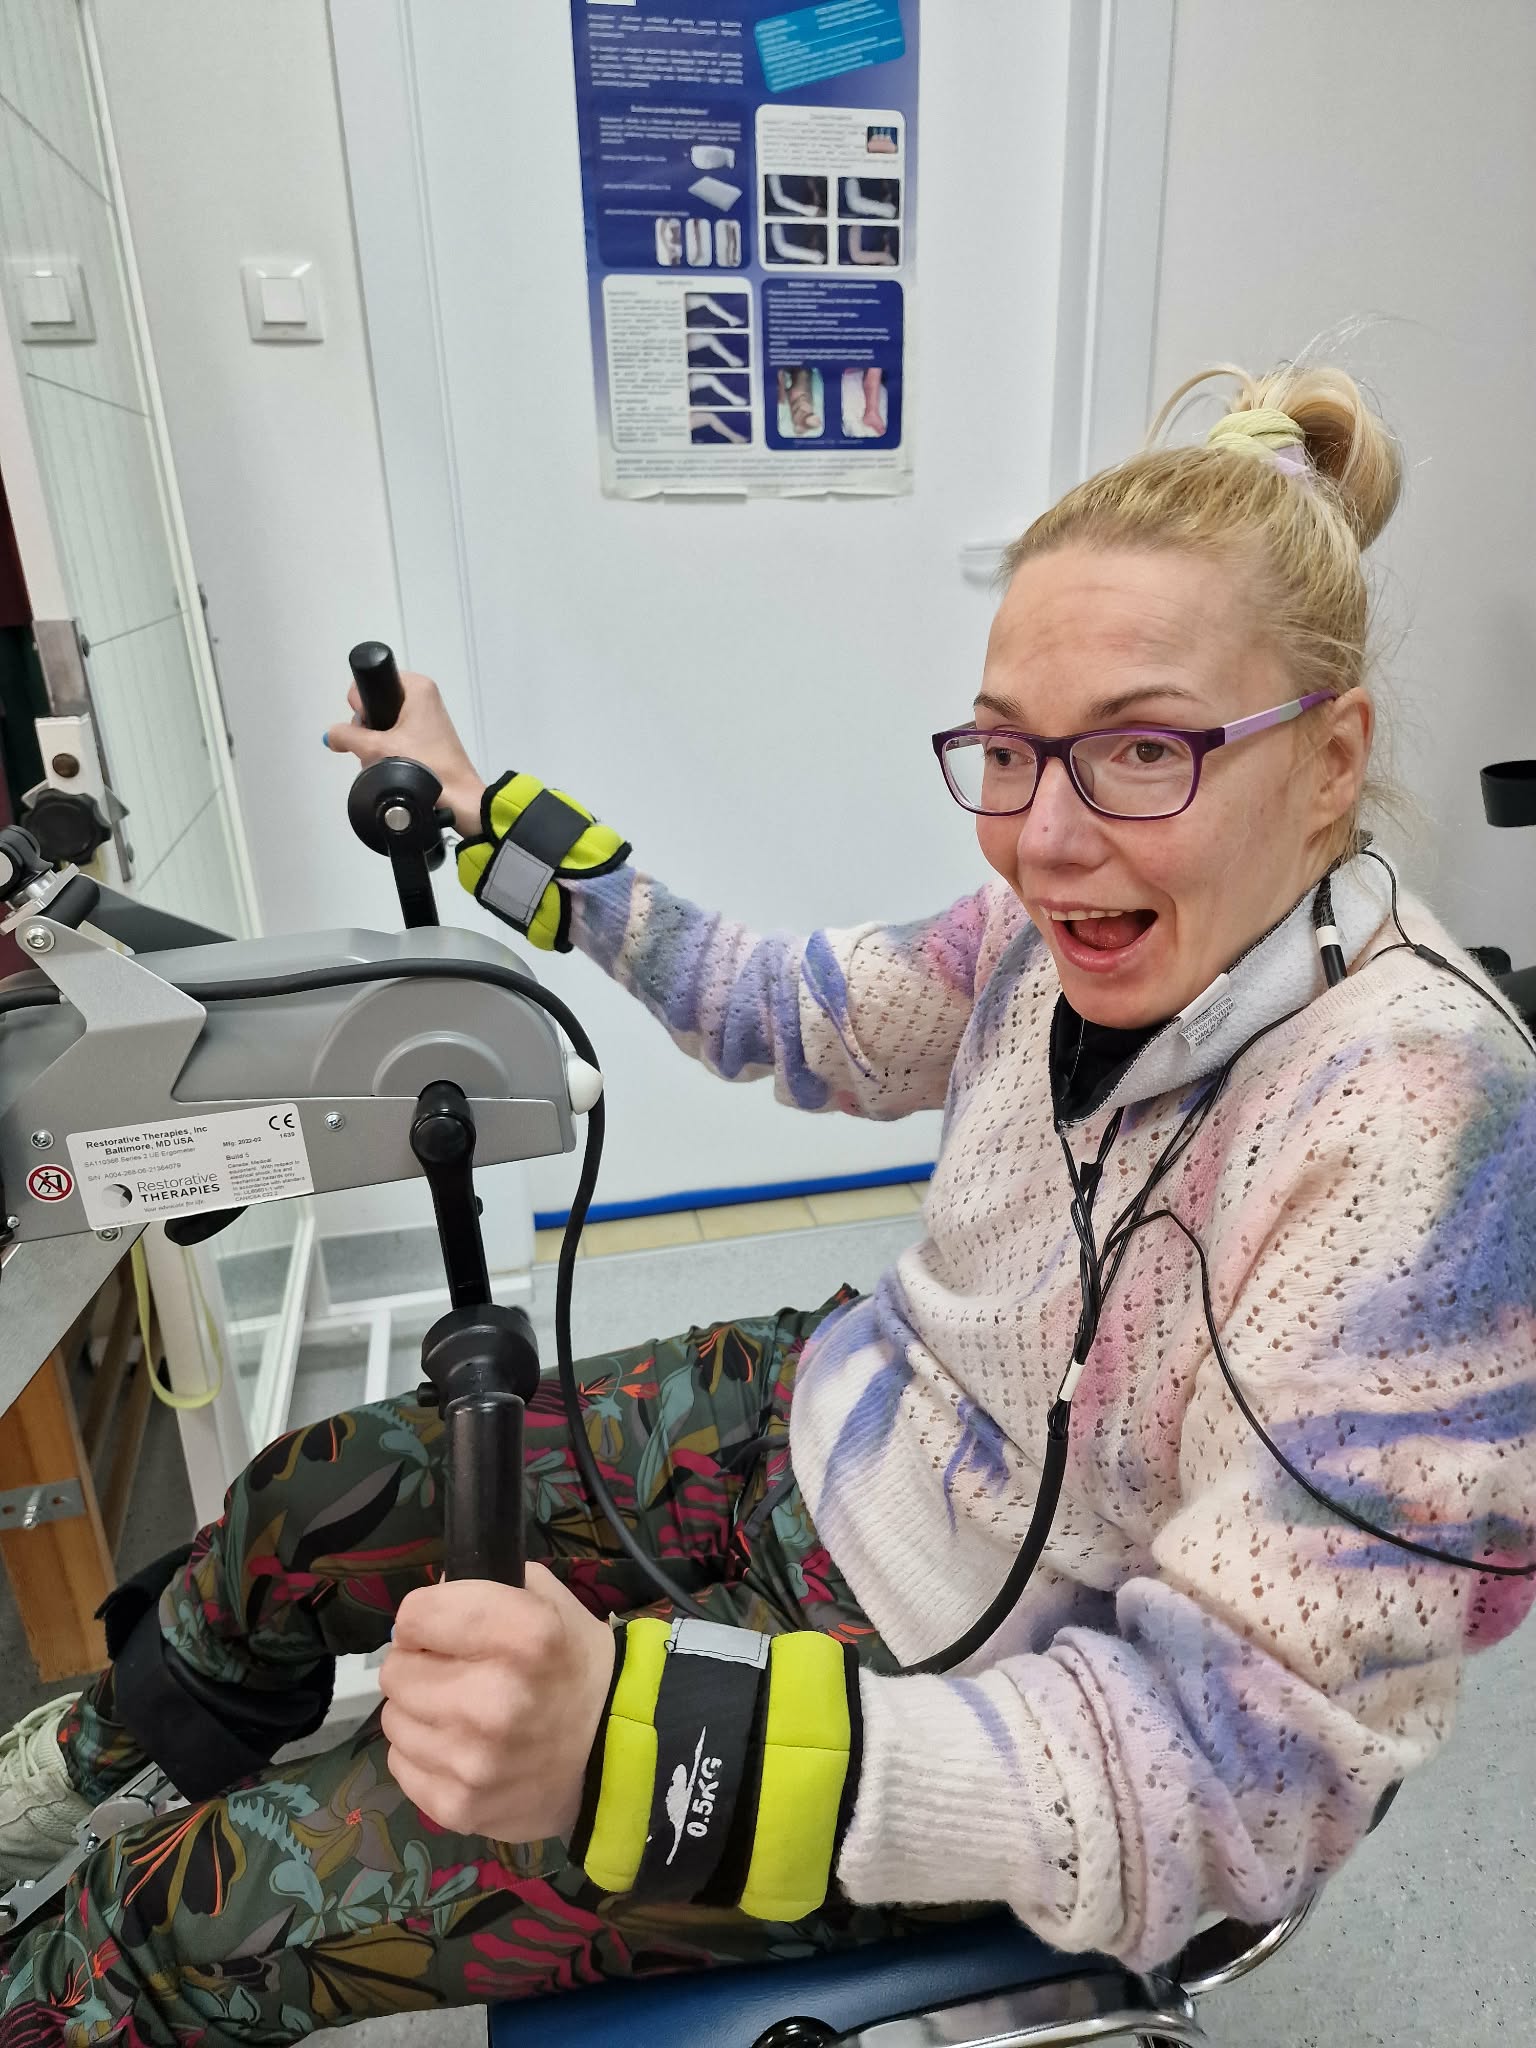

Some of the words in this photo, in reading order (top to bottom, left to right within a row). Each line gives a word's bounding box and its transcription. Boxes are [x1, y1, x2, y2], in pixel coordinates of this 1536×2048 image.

[86, 1136, 141, 1149] Restorative
[142, 1129, 192, 1140] Therapies,
[193, 1126, 208, 1134] Inc
[105, 1144, 154, 1155] Baltimore,
[156, 1140, 171, 1148] MD
[173, 1136, 194, 1146] USA
[225, 1153, 244, 1161] Build
[136, 1172, 218, 1193] Restorative
[140, 1183, 220, 1203] THERAPIES
[686, 1757, 723, 1837] 0.5KG
